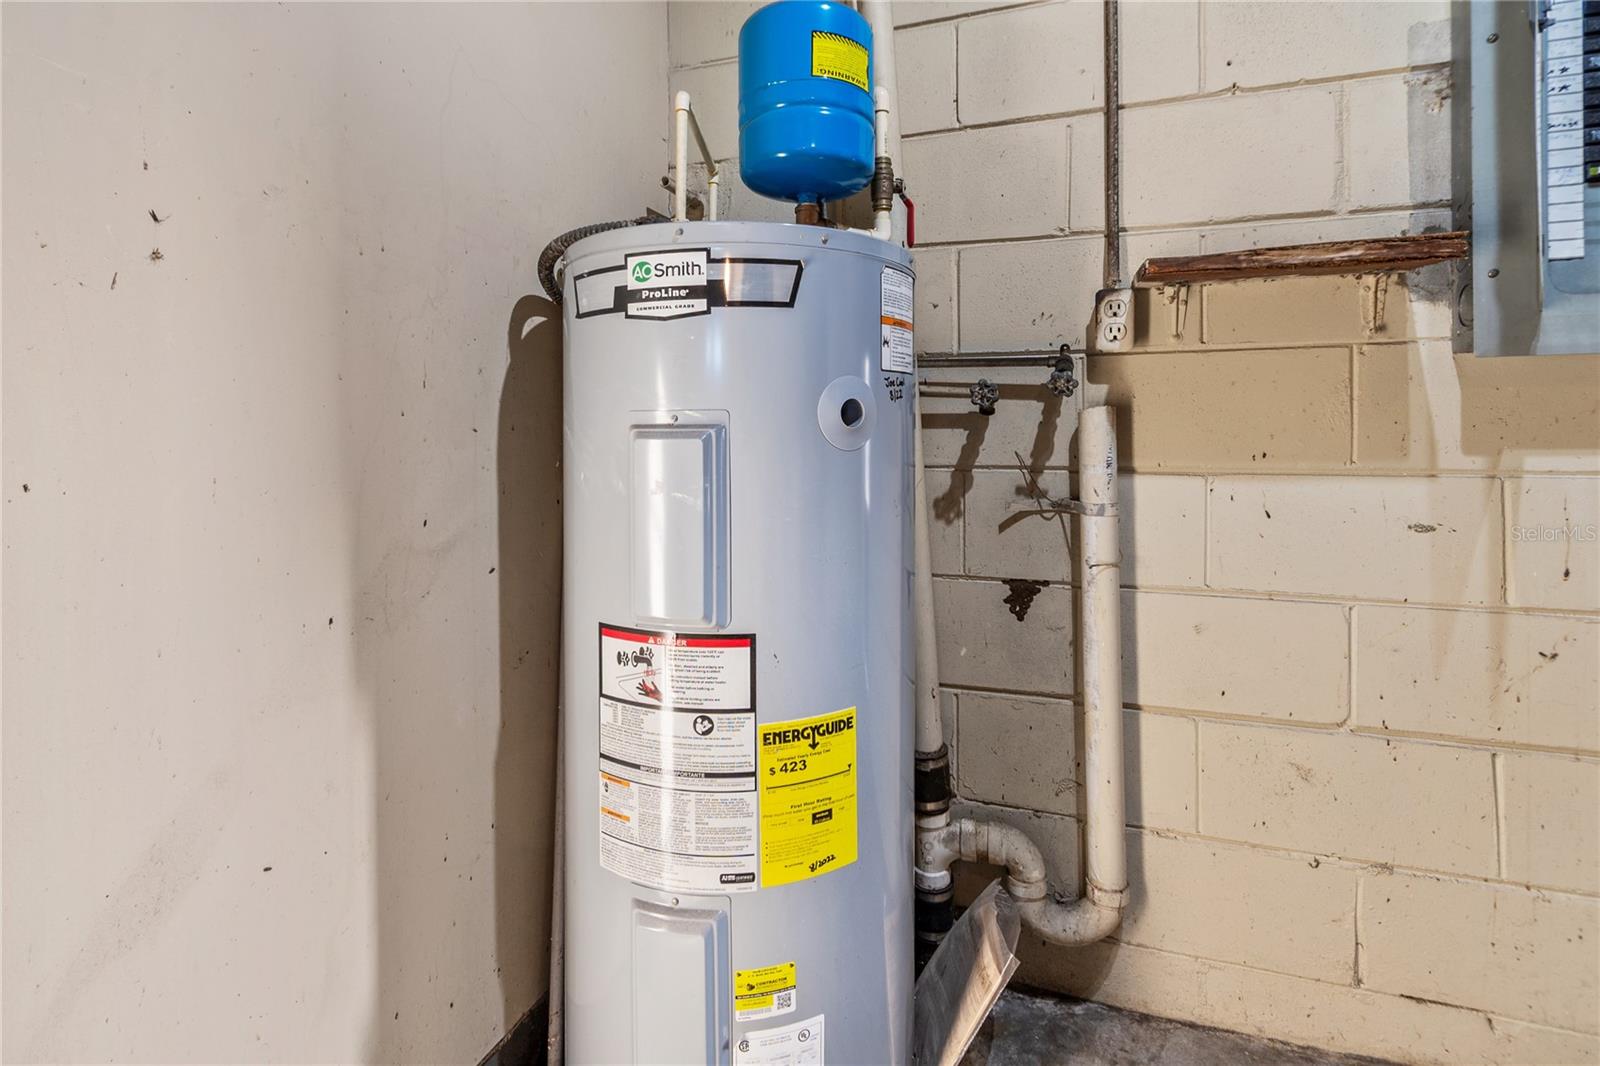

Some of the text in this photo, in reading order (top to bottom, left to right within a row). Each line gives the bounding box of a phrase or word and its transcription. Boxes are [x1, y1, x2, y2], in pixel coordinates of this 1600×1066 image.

[762, 716, 854, 747] ENERGYGUIDE
[769, 759, 807, 776] $ 423
[756, 977, 787, 987] CONTRACTOR
